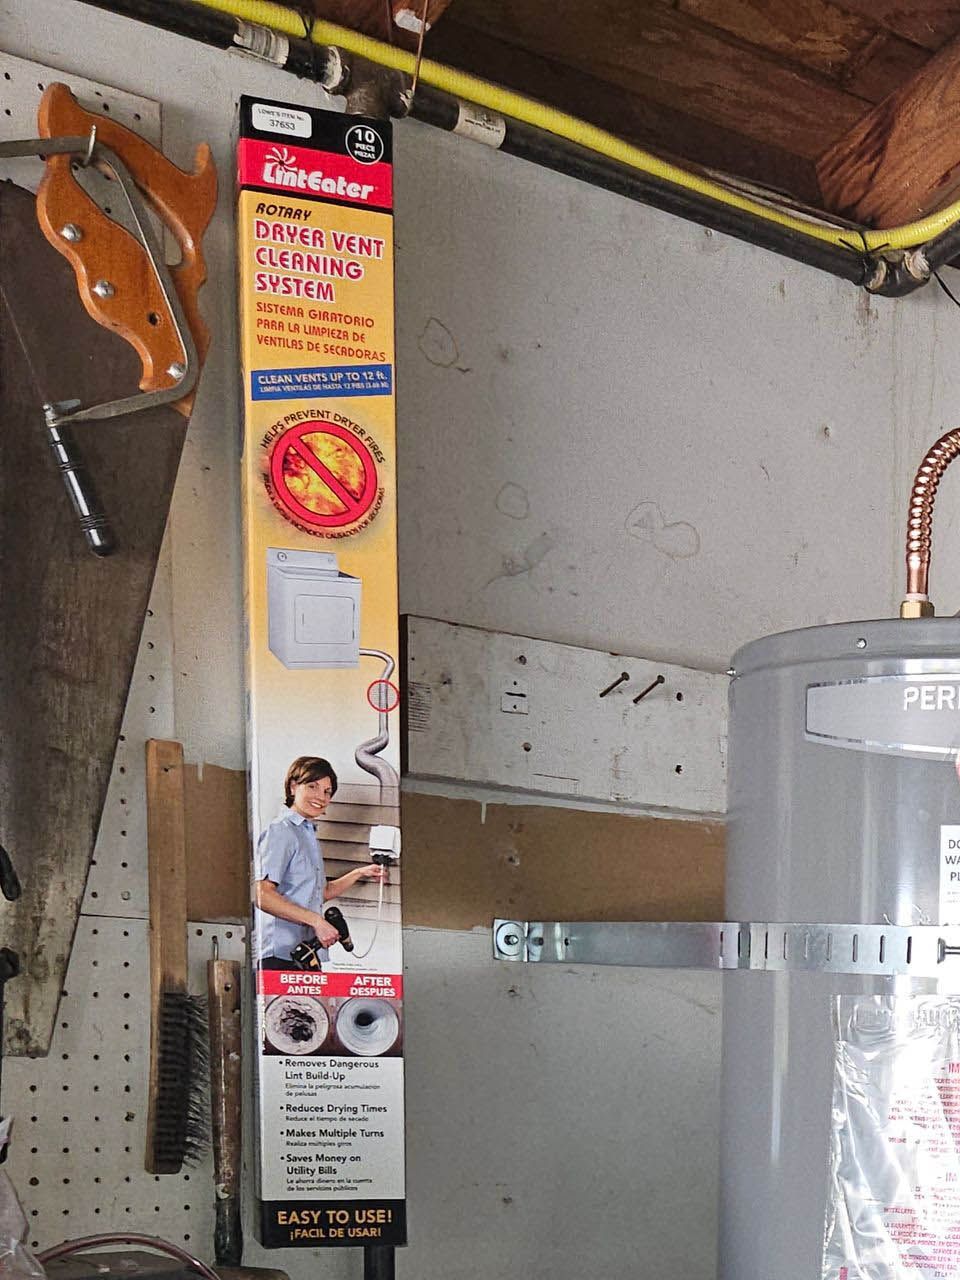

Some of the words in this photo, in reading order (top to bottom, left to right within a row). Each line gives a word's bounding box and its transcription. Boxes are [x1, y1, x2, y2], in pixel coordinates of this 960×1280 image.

[270, 120, 295, 130] 37653
[355, 129, 375, 143] 10
[355, 143, 375, 152] PIECE
[263, 162, 374, 199] LintEater
[256, 203, 312, 221] ROTARY
[255, 220, 325, 249] DRYER
[332, 232, 384, 258] VENT
[255, 247, 363, 280] CLEANING
[256, 273, 335, 301] SYSTEM
[257, 302, 304, 317] SISTEMA
[308, 309, 374, 328] GIRATORIO
[257, 318, 284, 331] PARA
[288, 323, 300, 333] LA
[304, 325, 349, 340] LIMPIEZA
[353, 333, 365, 343] DE
[257, 335, 304, 350] VENTILAS
[307, 342, 320, 352] DE
[324, 344, 386, 362] SECADORAS
[258, 375, 292, 385] CLEAN
[295, 374, 327, 383] VENTS
[331, 373, 343, 382] UP
[347, 372, 360, 381] TO
[363, 372, 374, 380] 12
[377, 371, 387, 380] ft.
[260, 422, 284, 449] HELPS
[284, 410, 331, 425] PREVENT
[333, 414, 366, 437] DRYER
[364, 436, 386, 464] FIRES
[280, 974, 328, 985] BEFORE
[354, 976, 392, 986] AFTER
[287, 985, 322, 995] ANTES
[350, 987, 396, 997] DESPUES
[285, 1059, 327, 1068] Removes
[330, 1059, 379, 1070] Dangerous
[285, 1072, 302, 1080] Lint
[306, 1071, 346, 1082] Build-Up
[286, 1104, 324, 1112] Reduces
[327, 1105, 358, 1114] Drying
[286, 1129, 316, 1137] Makes
[319, 1129, 357, 1139] Multiple
[360, 1129, 384, 1137] Turns
[287, 1154, 312, 1162] Saves
[316, 1154, 347, 1164] Money
[287, 1167, 316, 1177] Utility
[277, 1211, 320, 1225] EASY
[326, 1210, 349, 1223] TO
[355, 1210, 392, 1223] USE!
[329, 1228, 345, 1238] DE
[348, 1228, 381, 1237] USAR!
